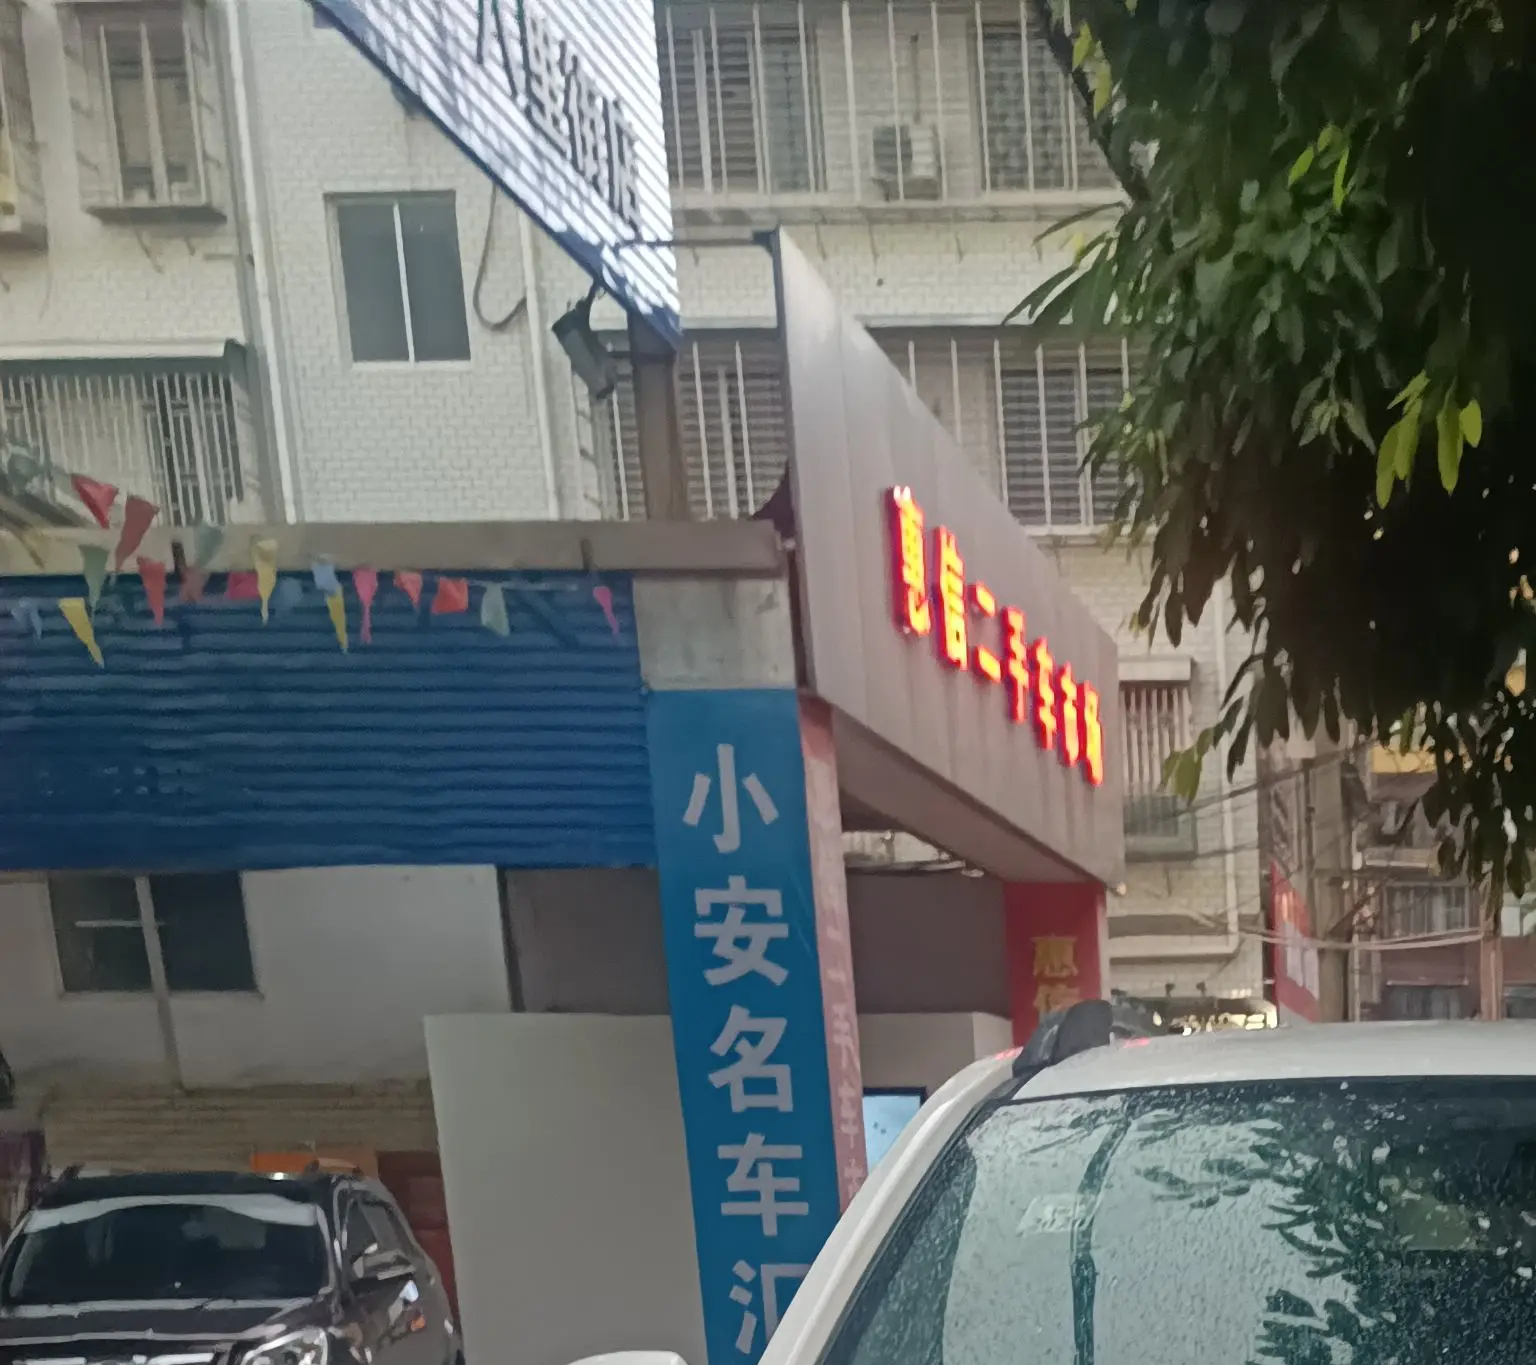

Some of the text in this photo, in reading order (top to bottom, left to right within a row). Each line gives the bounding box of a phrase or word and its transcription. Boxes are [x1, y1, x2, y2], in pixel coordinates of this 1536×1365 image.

[682, 743, 811, 1355] 小安名车汇
